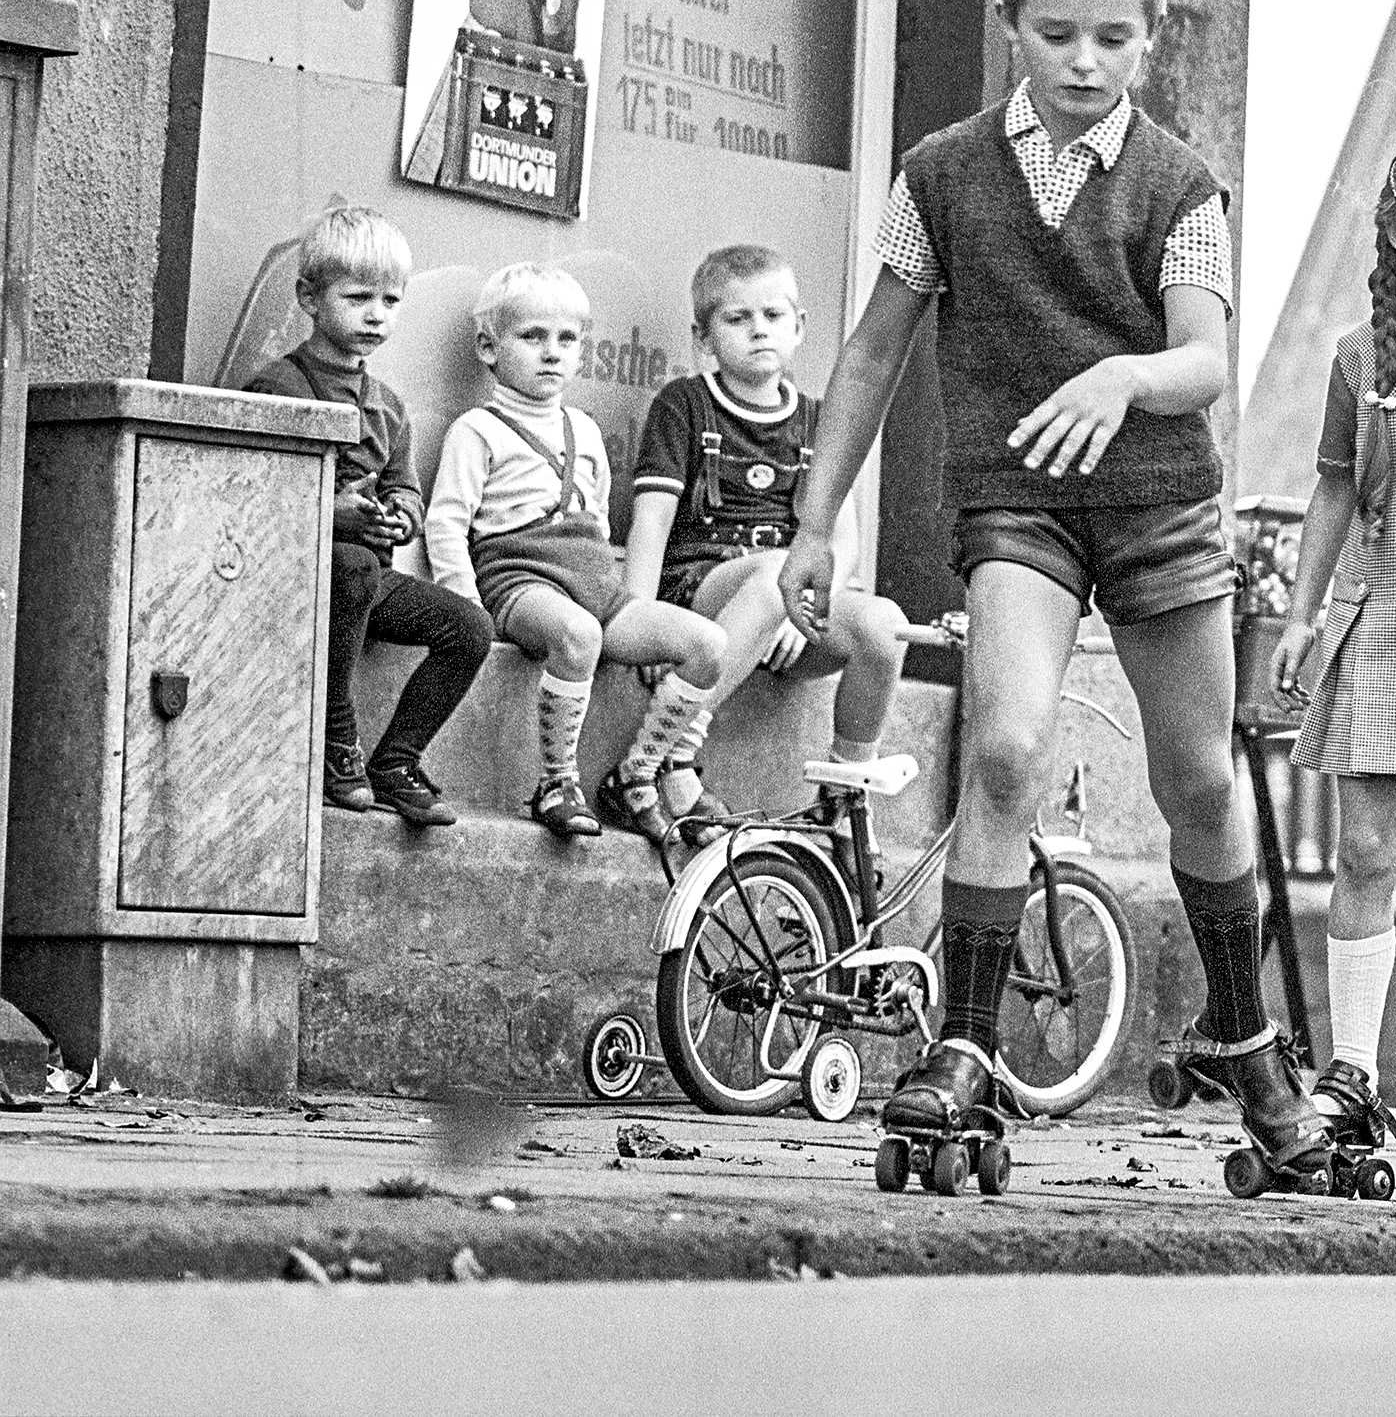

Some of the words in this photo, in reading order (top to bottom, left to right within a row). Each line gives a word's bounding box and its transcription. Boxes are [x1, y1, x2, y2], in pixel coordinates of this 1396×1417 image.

[623, 12, 675, 72] jetzt
[683, 36, 723, 85] nur
[730, 43, 786, 104] noch
[664, 109, 700, 145] für
[471, 132, 558, 168] DORTMUNDER
[468, 148, 558, 198] UNION
